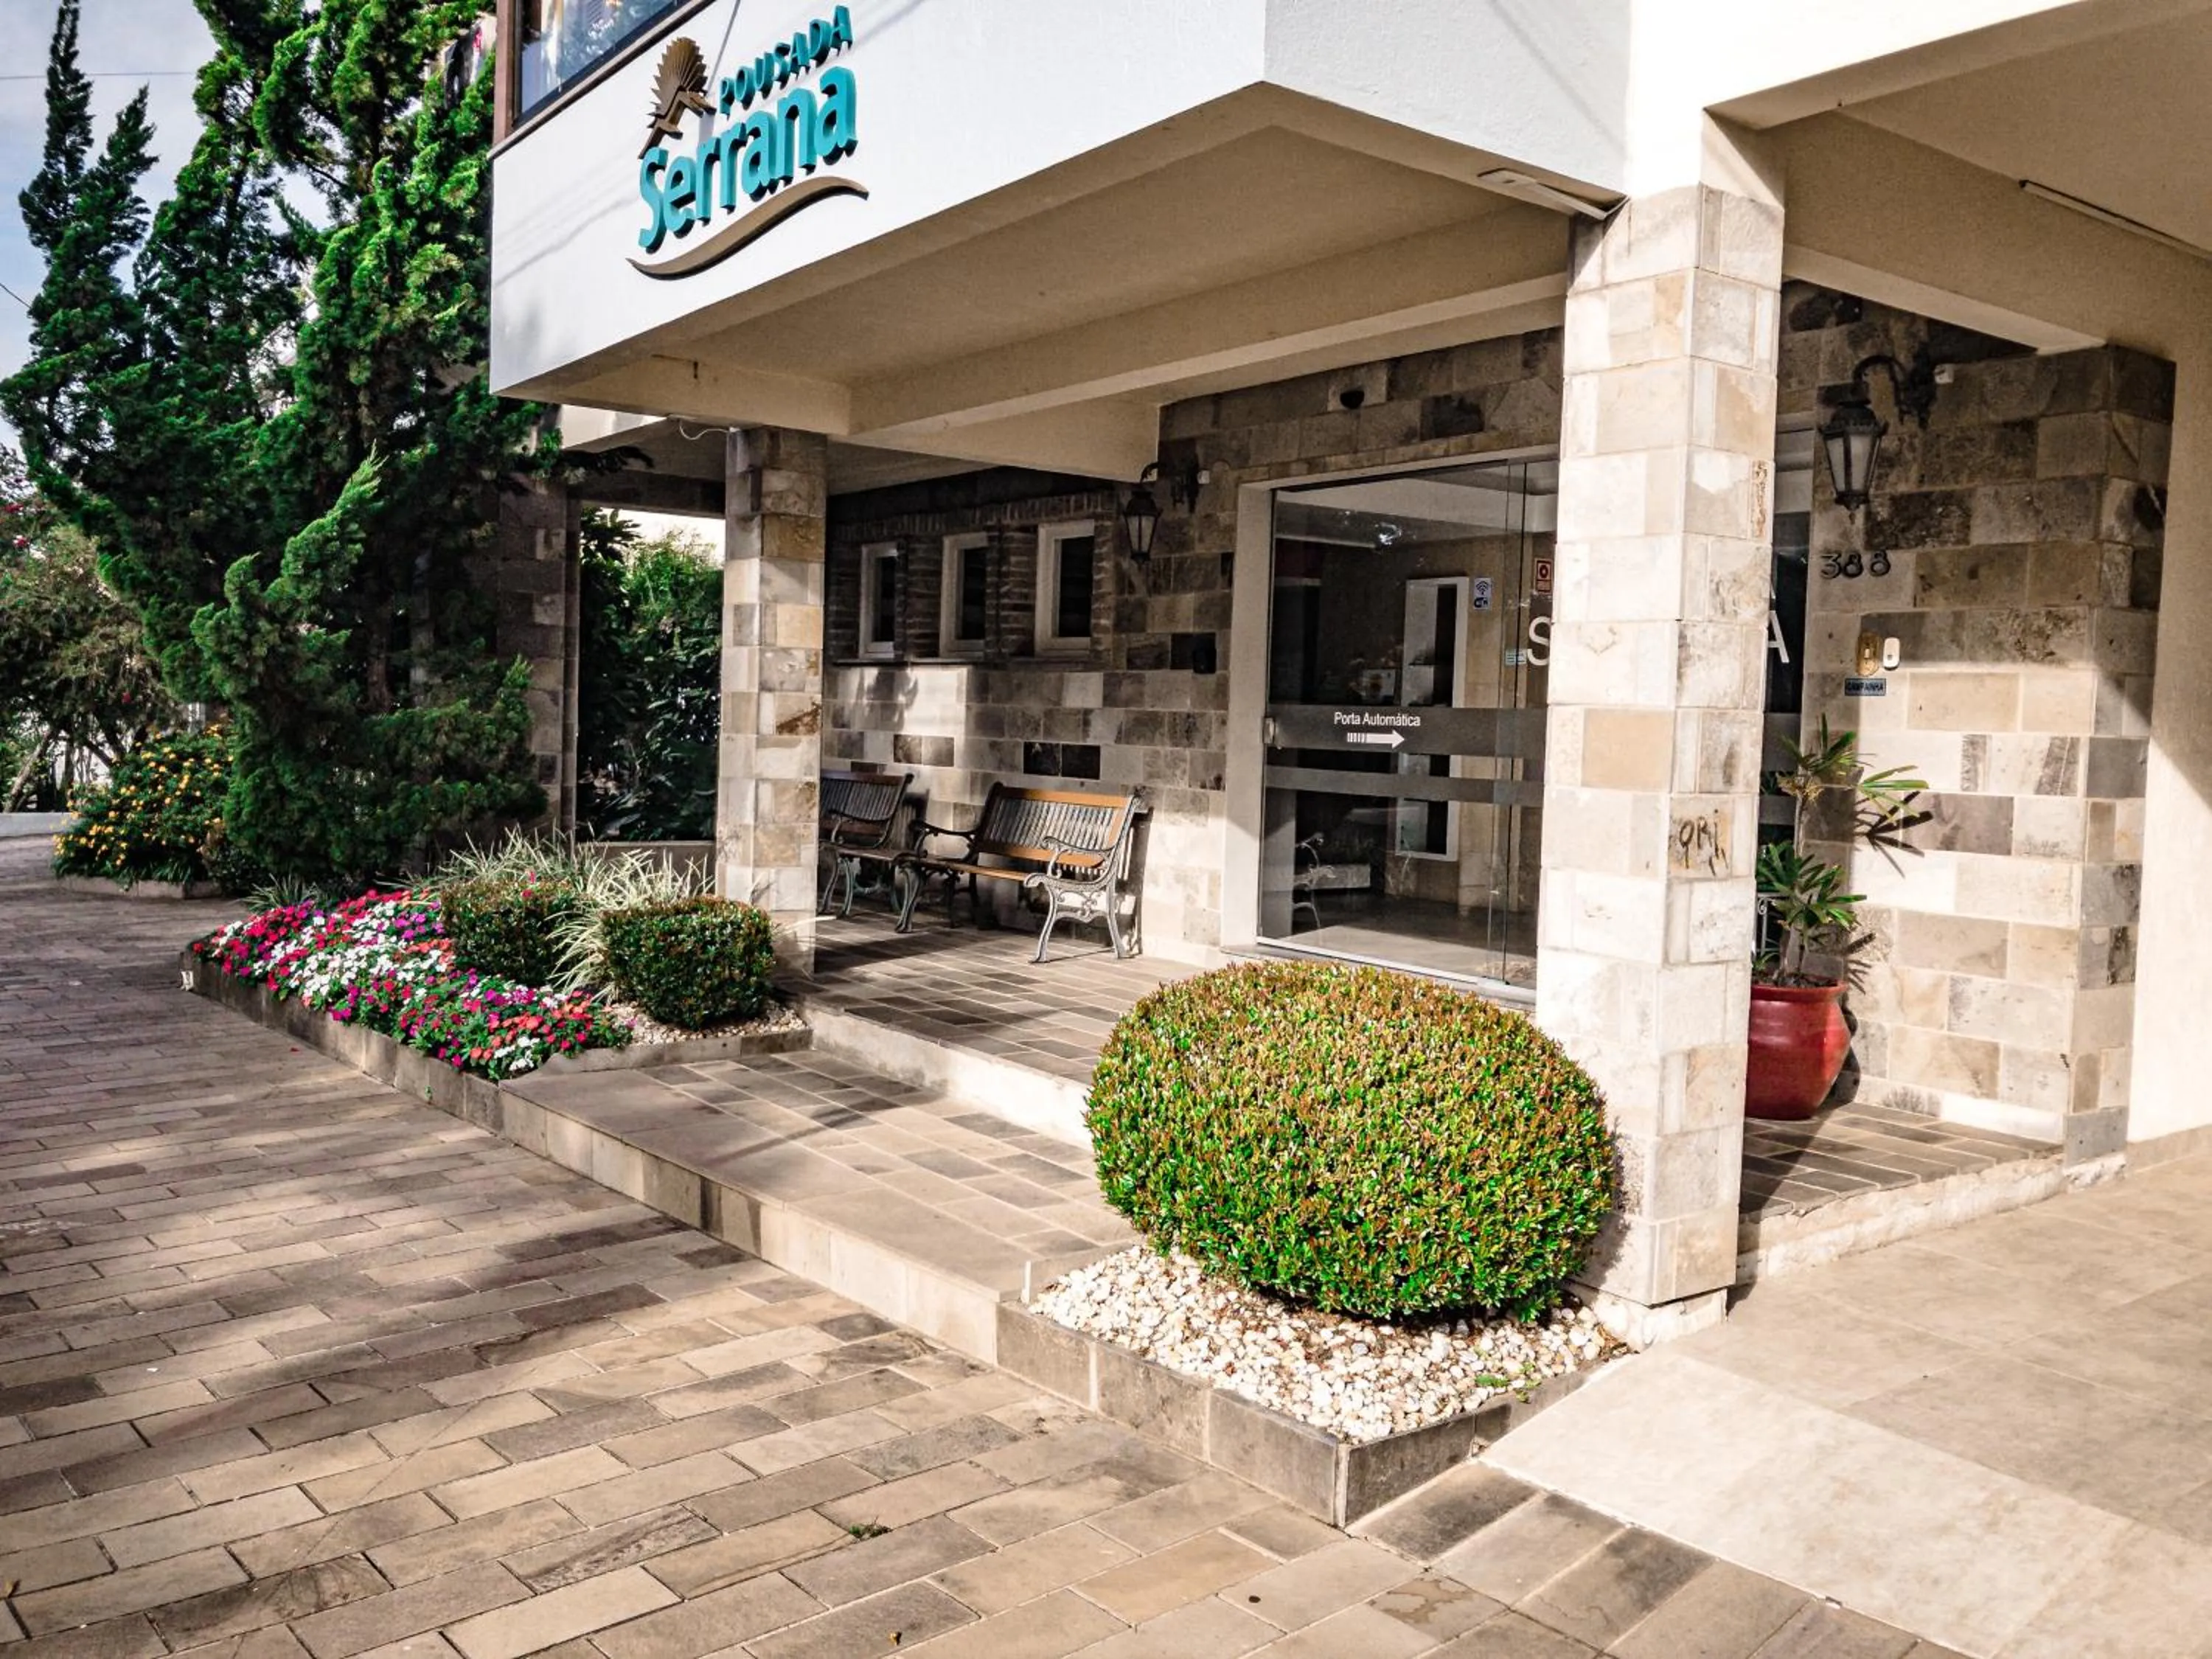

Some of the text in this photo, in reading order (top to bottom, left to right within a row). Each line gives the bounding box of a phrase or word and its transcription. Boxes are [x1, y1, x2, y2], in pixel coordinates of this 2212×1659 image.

[719, 5, 853, 118] POUSADA
[638, 66, 858, 253] Serrana
[1820, 549, 1891, 579] 388
[1334, 712, 1421, 726] Porta Automática
